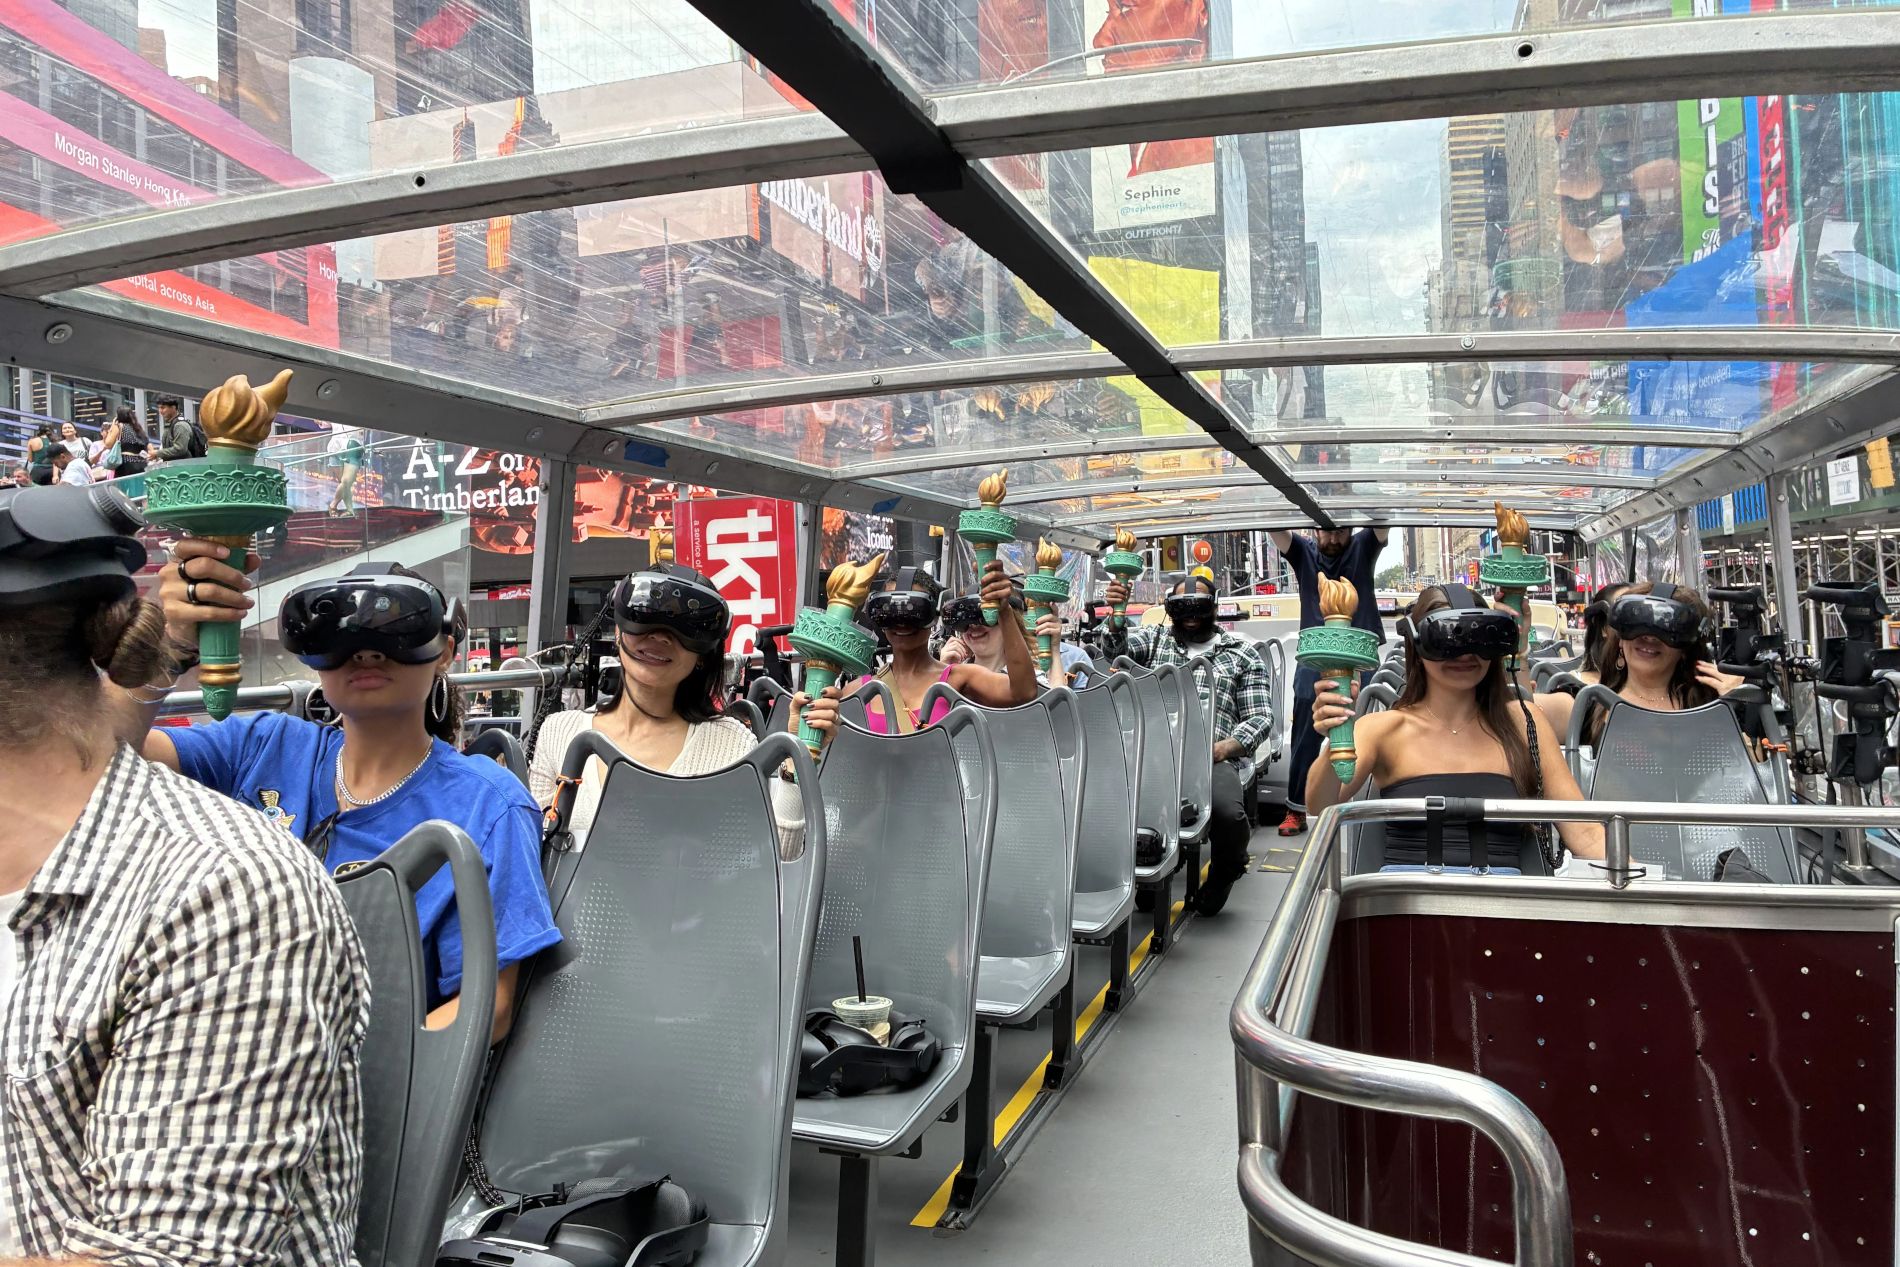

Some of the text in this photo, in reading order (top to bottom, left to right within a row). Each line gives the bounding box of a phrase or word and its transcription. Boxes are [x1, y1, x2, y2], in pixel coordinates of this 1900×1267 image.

[55, 132, 99, 170] Morgan
[102, 157, 142, 188] Stanley
[144, 177, 171, 205] Hong
[1124, 185, 1182, 201] Sephine
[760, 179, 862, 262] mberland
[160, 284, 193, 305] across
[402, 479, 540, 513] Timberlan
[694, 527, 702, 558] service
[866, 526, 894, 551] Iconic
